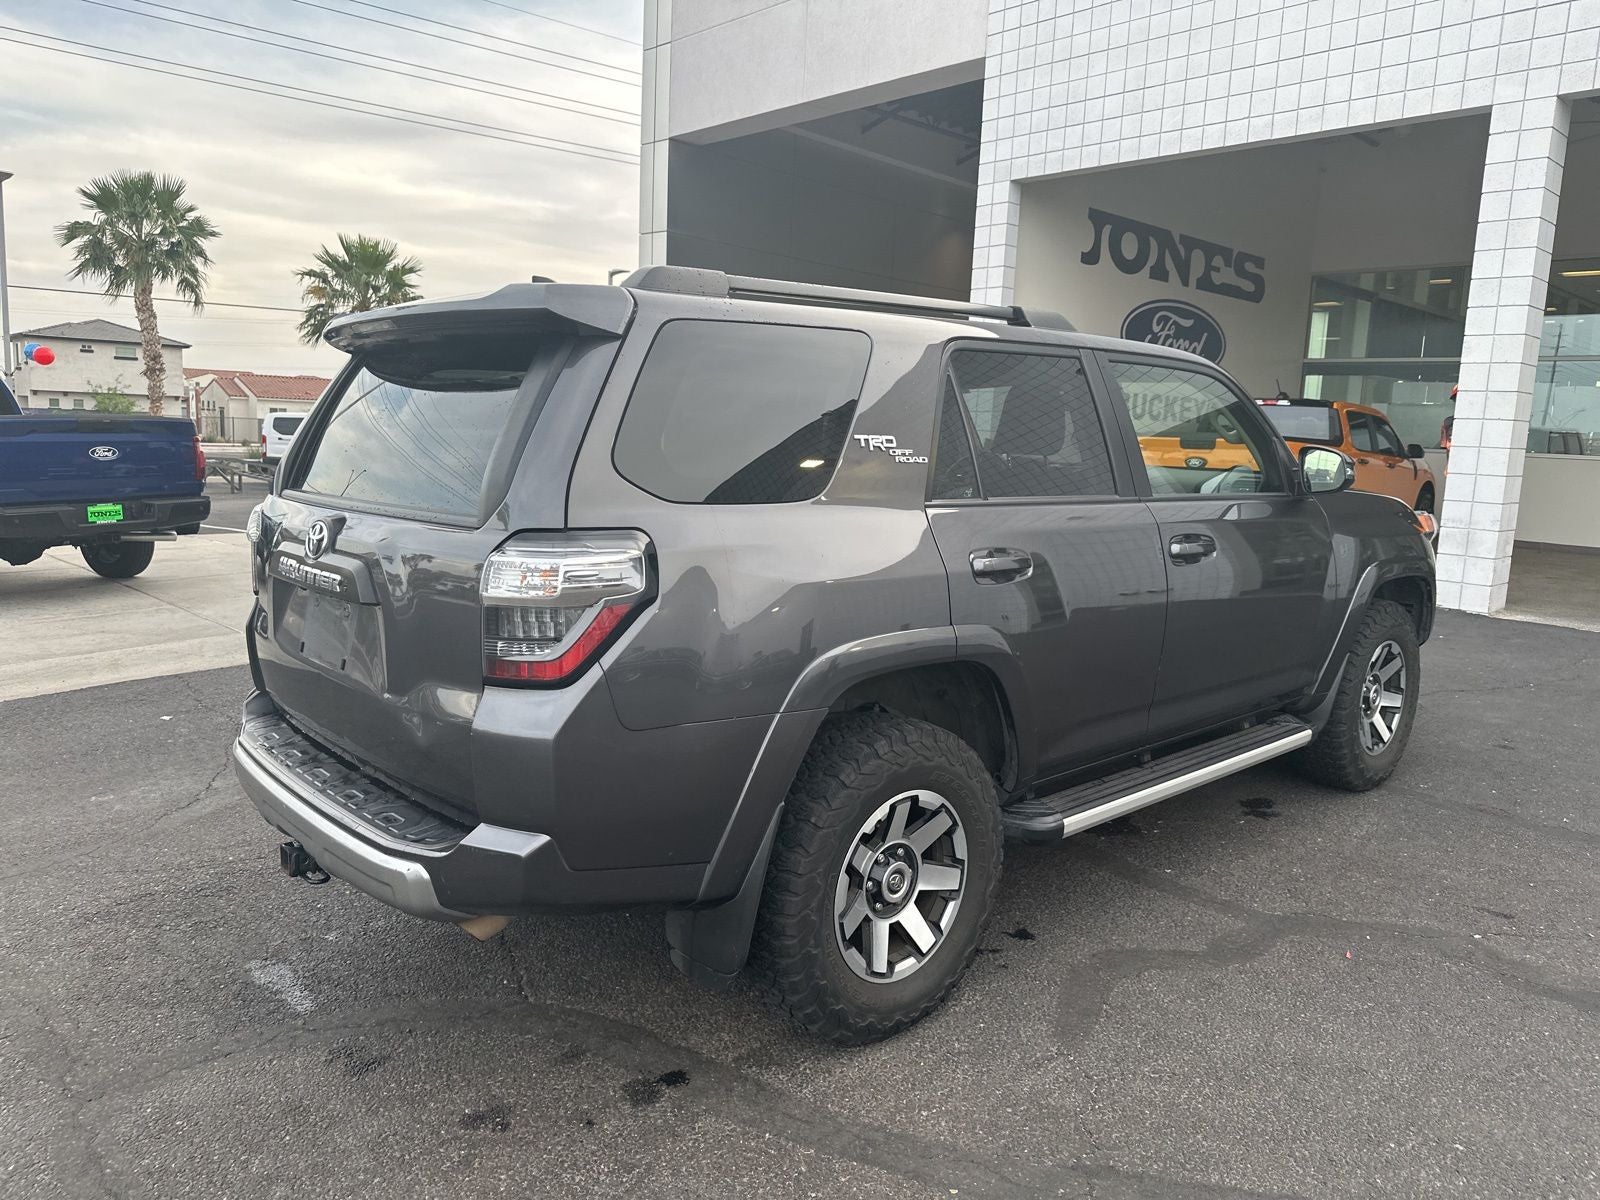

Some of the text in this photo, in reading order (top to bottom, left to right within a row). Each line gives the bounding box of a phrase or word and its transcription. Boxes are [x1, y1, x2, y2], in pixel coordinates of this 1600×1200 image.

[1080, 207, 1266, 303] JONES
[854, 434, 897, 451] TRD
[94, 448, 114, 457] Ford
[889, 448, 914, 456] OFF
[895, 456, 929, 464] ROAD
[89, 510, 122, 518] JONES
